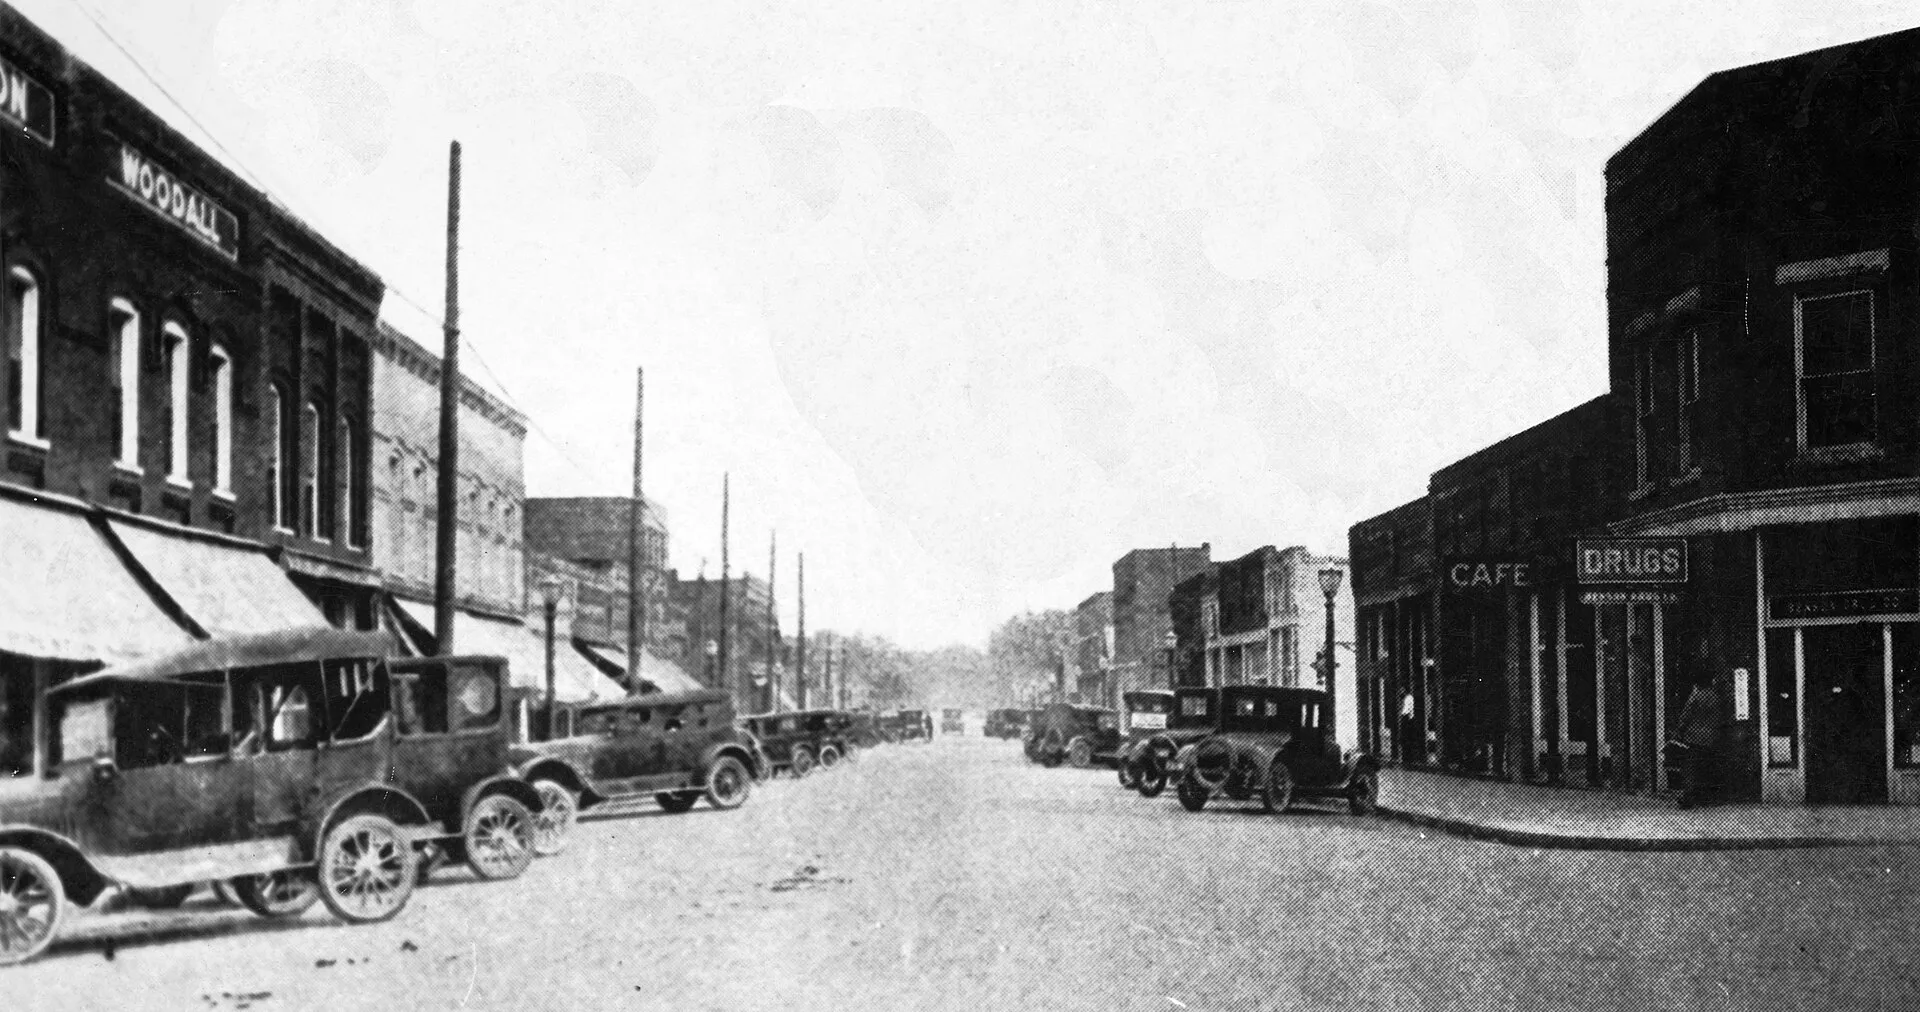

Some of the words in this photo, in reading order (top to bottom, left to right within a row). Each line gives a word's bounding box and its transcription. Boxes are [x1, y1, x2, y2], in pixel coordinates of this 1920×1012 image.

[121, 144, 220, 243] WOODALL
[1451, 562, 1530, 586] CAFE
[1584, 547, 1681, 575] DRUGS
